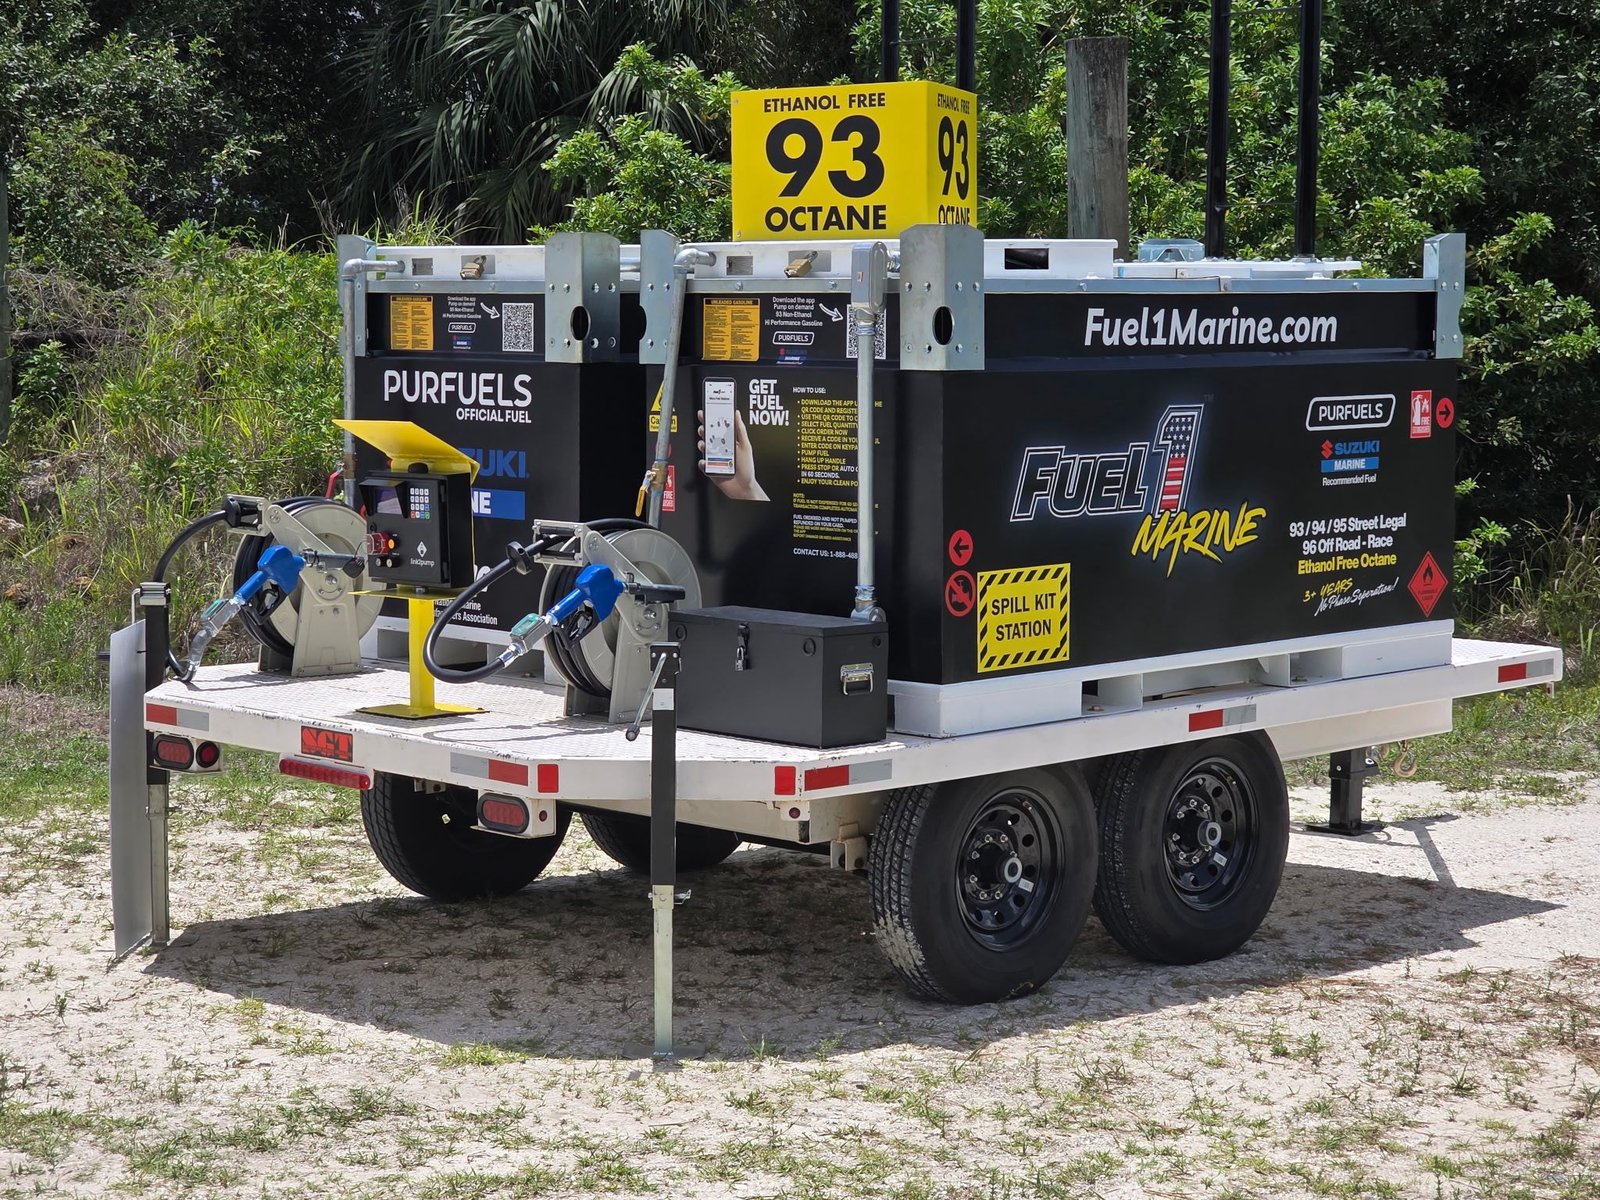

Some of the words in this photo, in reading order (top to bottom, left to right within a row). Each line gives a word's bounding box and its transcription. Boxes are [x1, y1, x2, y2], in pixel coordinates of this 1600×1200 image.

[763, 95, 840, 113] ETHANOL
[848, 92, 886, 109] FREE
[937, 93, 960, 112] ETHANOL
[960, 99, 970, 115] FREE
[765, 115, 886, 198] 93
[938, 115, 970, 200] 93
[765, 204, 887, 232] OCTANE
[1084, 306, 1338, 346] Fuel1Marine.com
[778, 334, 809, 342] PURFUELS
[384, 369, 532, 408] PURFUELS
[749, 378, 777, 395] GET
[749, 394, 784, 411] FUEL
[1318, 403, 1384, 422] PURFUELS
[456, 407, 504, 422] OFFICIAL
[505, 409, 532, 424] FUEL
[749, 410, 790, 427] NOW!
[1334, 440, 1380, 455] SUZUKI
[1334, 458, 1366, 471] MARINE
[1322, 475, 1364, 487] Recommended
[1364, 474, 1377, 483] Fuel
[1289, 521, 1304, 538] 93
[1311, 520, 1326, 536] 94
[1333, 518, 1347, 533] 95
[1347, 515, 1379, 532] Street
[1379, 512, 1407, 532] Legal
[1131, 501, 1267, 578] MARINE
[1302, 540, 1317, 556] 96
[1317, 538, 1334, 554] Off
[1335, 536, 1361, 552] Road
[1367, 534, 1393, 549] Race
[793, 548, 819, 556] CONTACT
[410, 557, 436, 568] link2pump
[1297, 556, 1336, 575] Ethanol
[1336, 556, 1359, 571] Free
[1360, 553, 1397, 568] Octane
[1302, 590, 1317, 602] 3+
[1320, 577, 1353, 597] YEARS
[462, 600, 482, 611] arine
[991, 595, 1030, 616] SPILL
[1034, 592, 1056, 610] KIT
[1314, 596, 1329, 616] No
[462, 611, 498, 626] Association
[995, 618, 1052, 642] STATION
